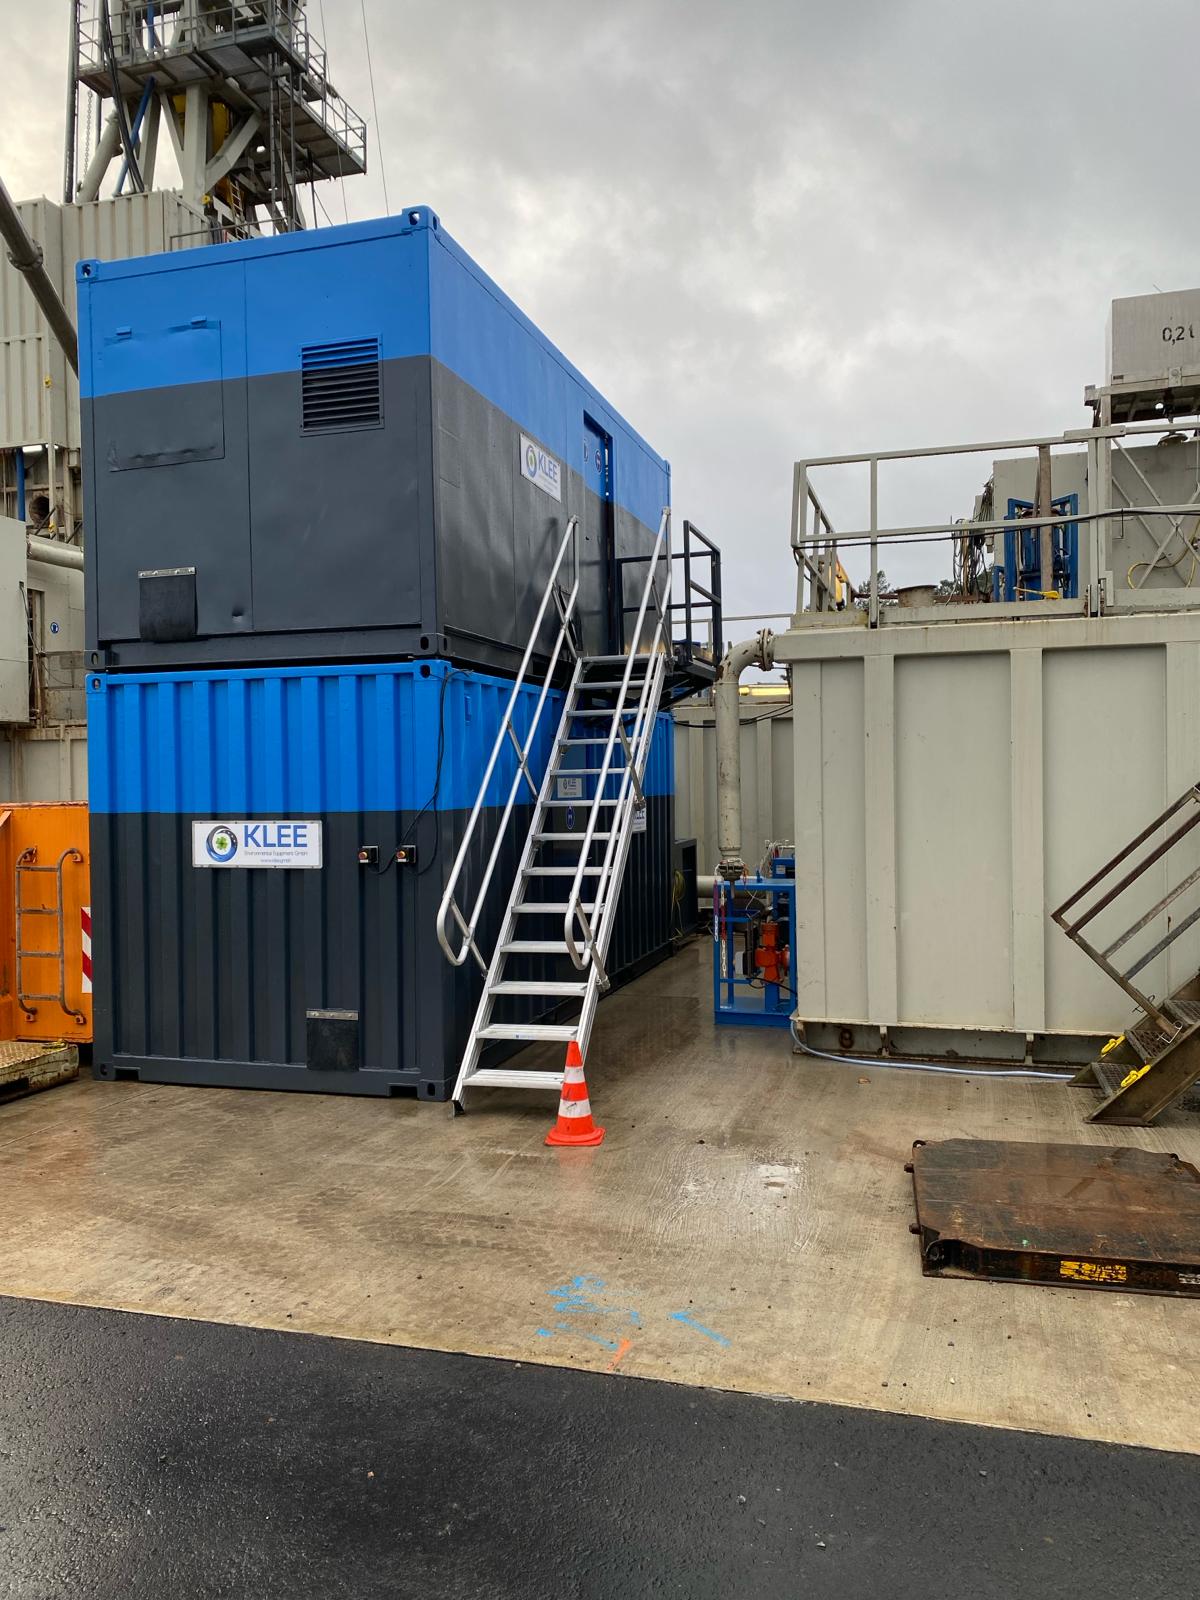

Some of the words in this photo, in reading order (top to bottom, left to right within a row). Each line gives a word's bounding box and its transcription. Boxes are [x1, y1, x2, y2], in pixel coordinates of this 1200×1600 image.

[1162, 326, 1185, 346] 0,2
[538, 450, 558, 484] KLEE
[243, 824, 308, 848] KLEE
